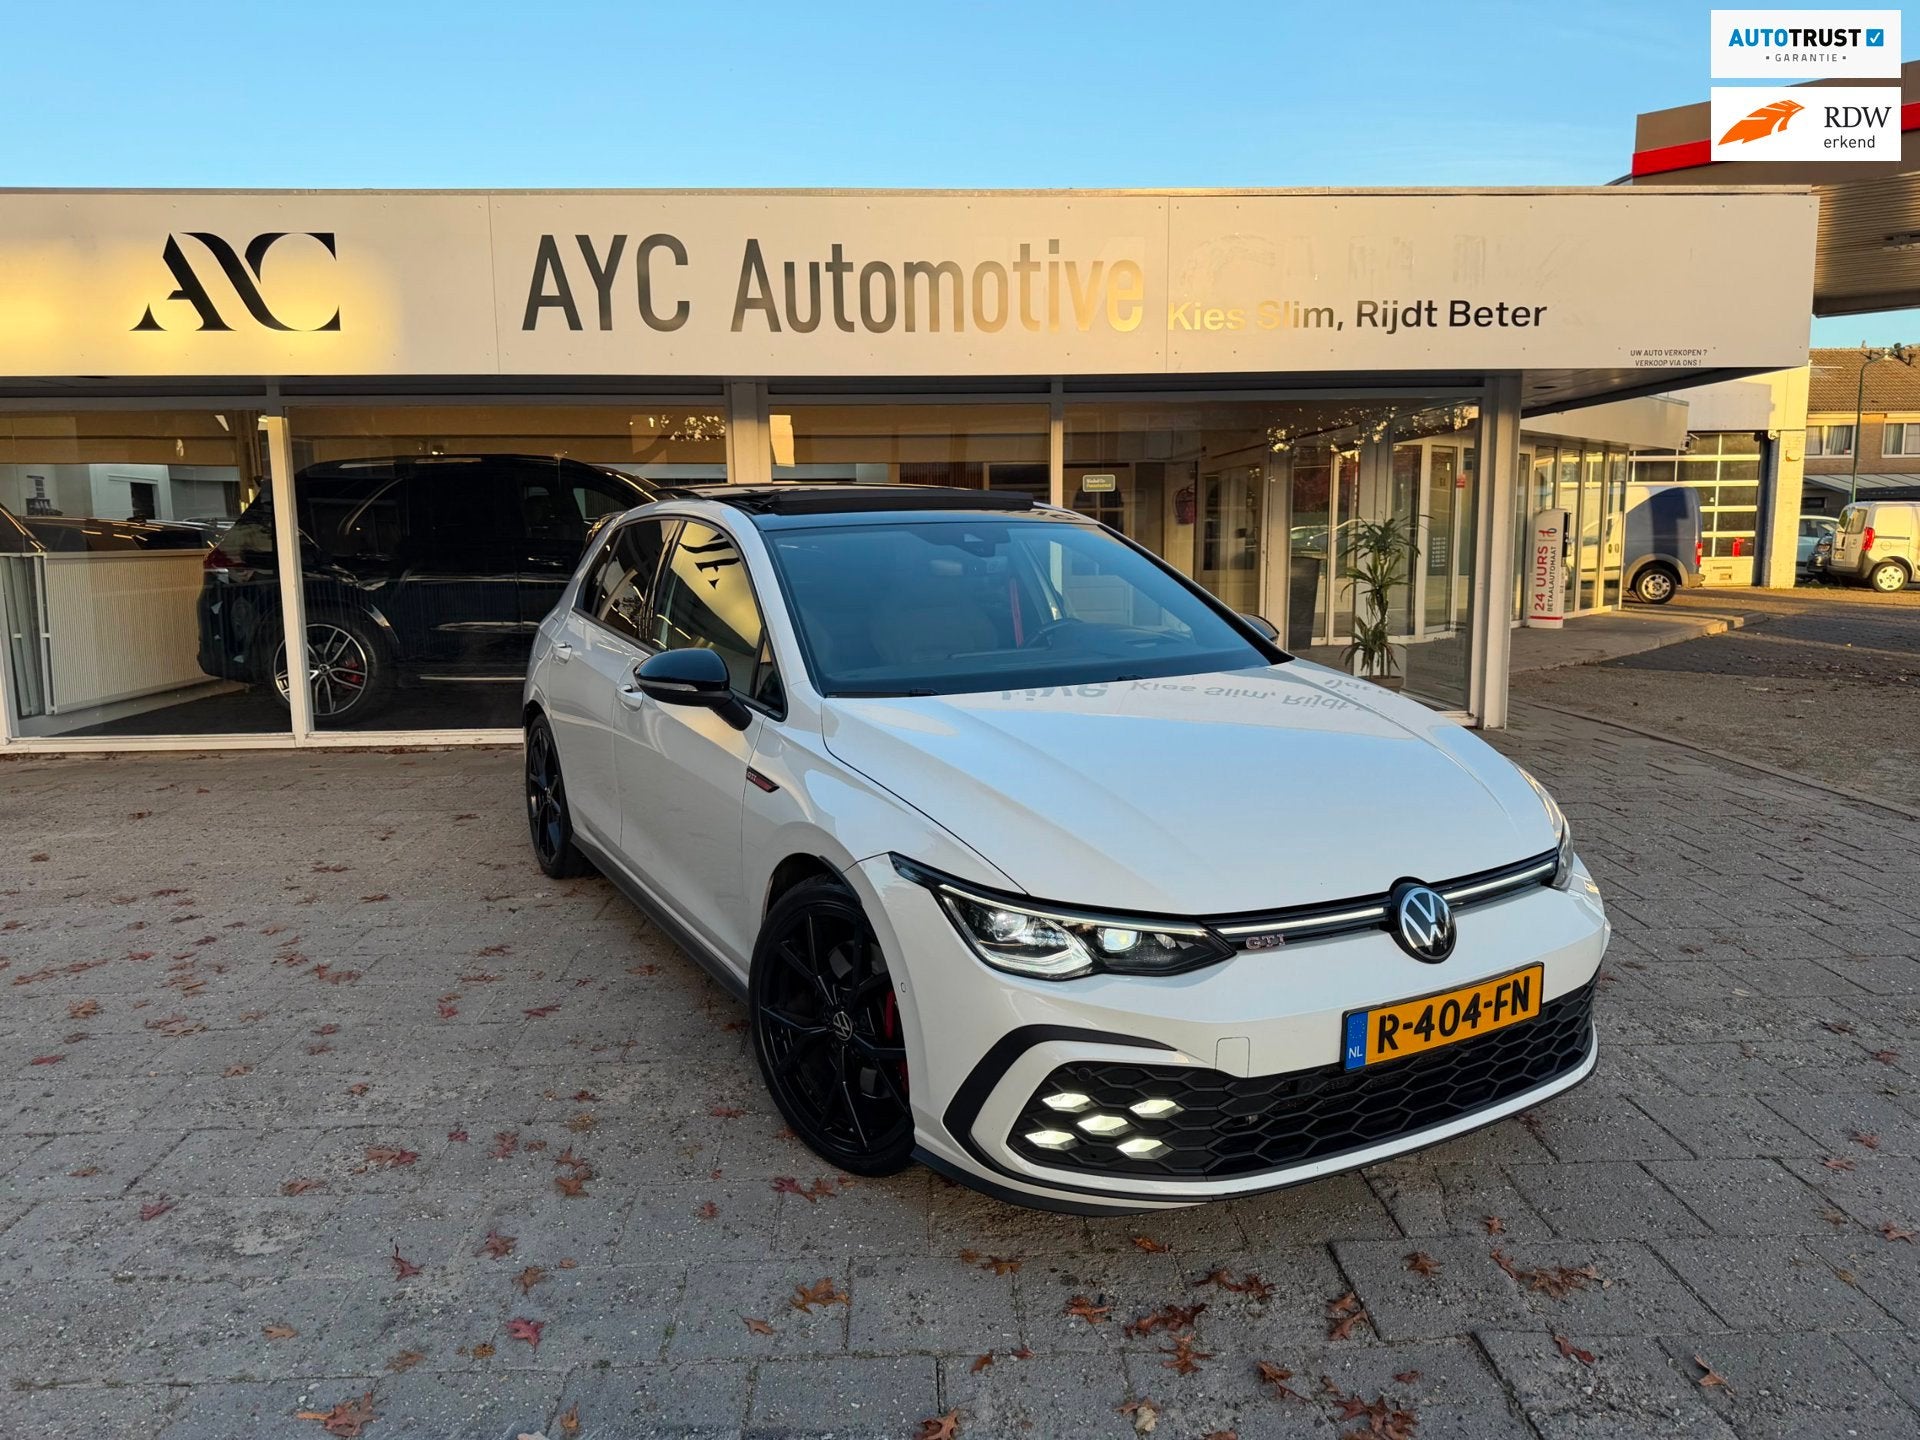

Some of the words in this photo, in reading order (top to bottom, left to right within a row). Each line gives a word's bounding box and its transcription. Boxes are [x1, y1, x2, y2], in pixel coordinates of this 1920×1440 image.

[522, 233, 690, 332] AYC
[730, 238, 1145, 333] Automotive
[1168, 302, 1246, 331] Kies
[1256, 299, 1344, 332] Slim,
[1356, 300, 1438, 335] Rijdt
[1449, 300, 1548, 328] Beter
[1630, 349, 1642, 357] UW
[1643, 349, 1663, 357] AUTO
[1664, 349, 1702, 357] VERKOPEN
[1635, 359, 1668, 367] VERKOOP
[1669, 359, 1681, 367] VIA
[1682, 359, 1698, 367] ONS
[1536, 545, 1549, 588] UURS
[1547, 546, 1557, 613] BETAALAUTOMAAT
[1534, 592, 1546, 612] 24
[1245, 933, 1287, 950] GTI
[1377, 975, 1531, 1054] R-404-FN
[1348, 1045, 1363, 1059] NL
